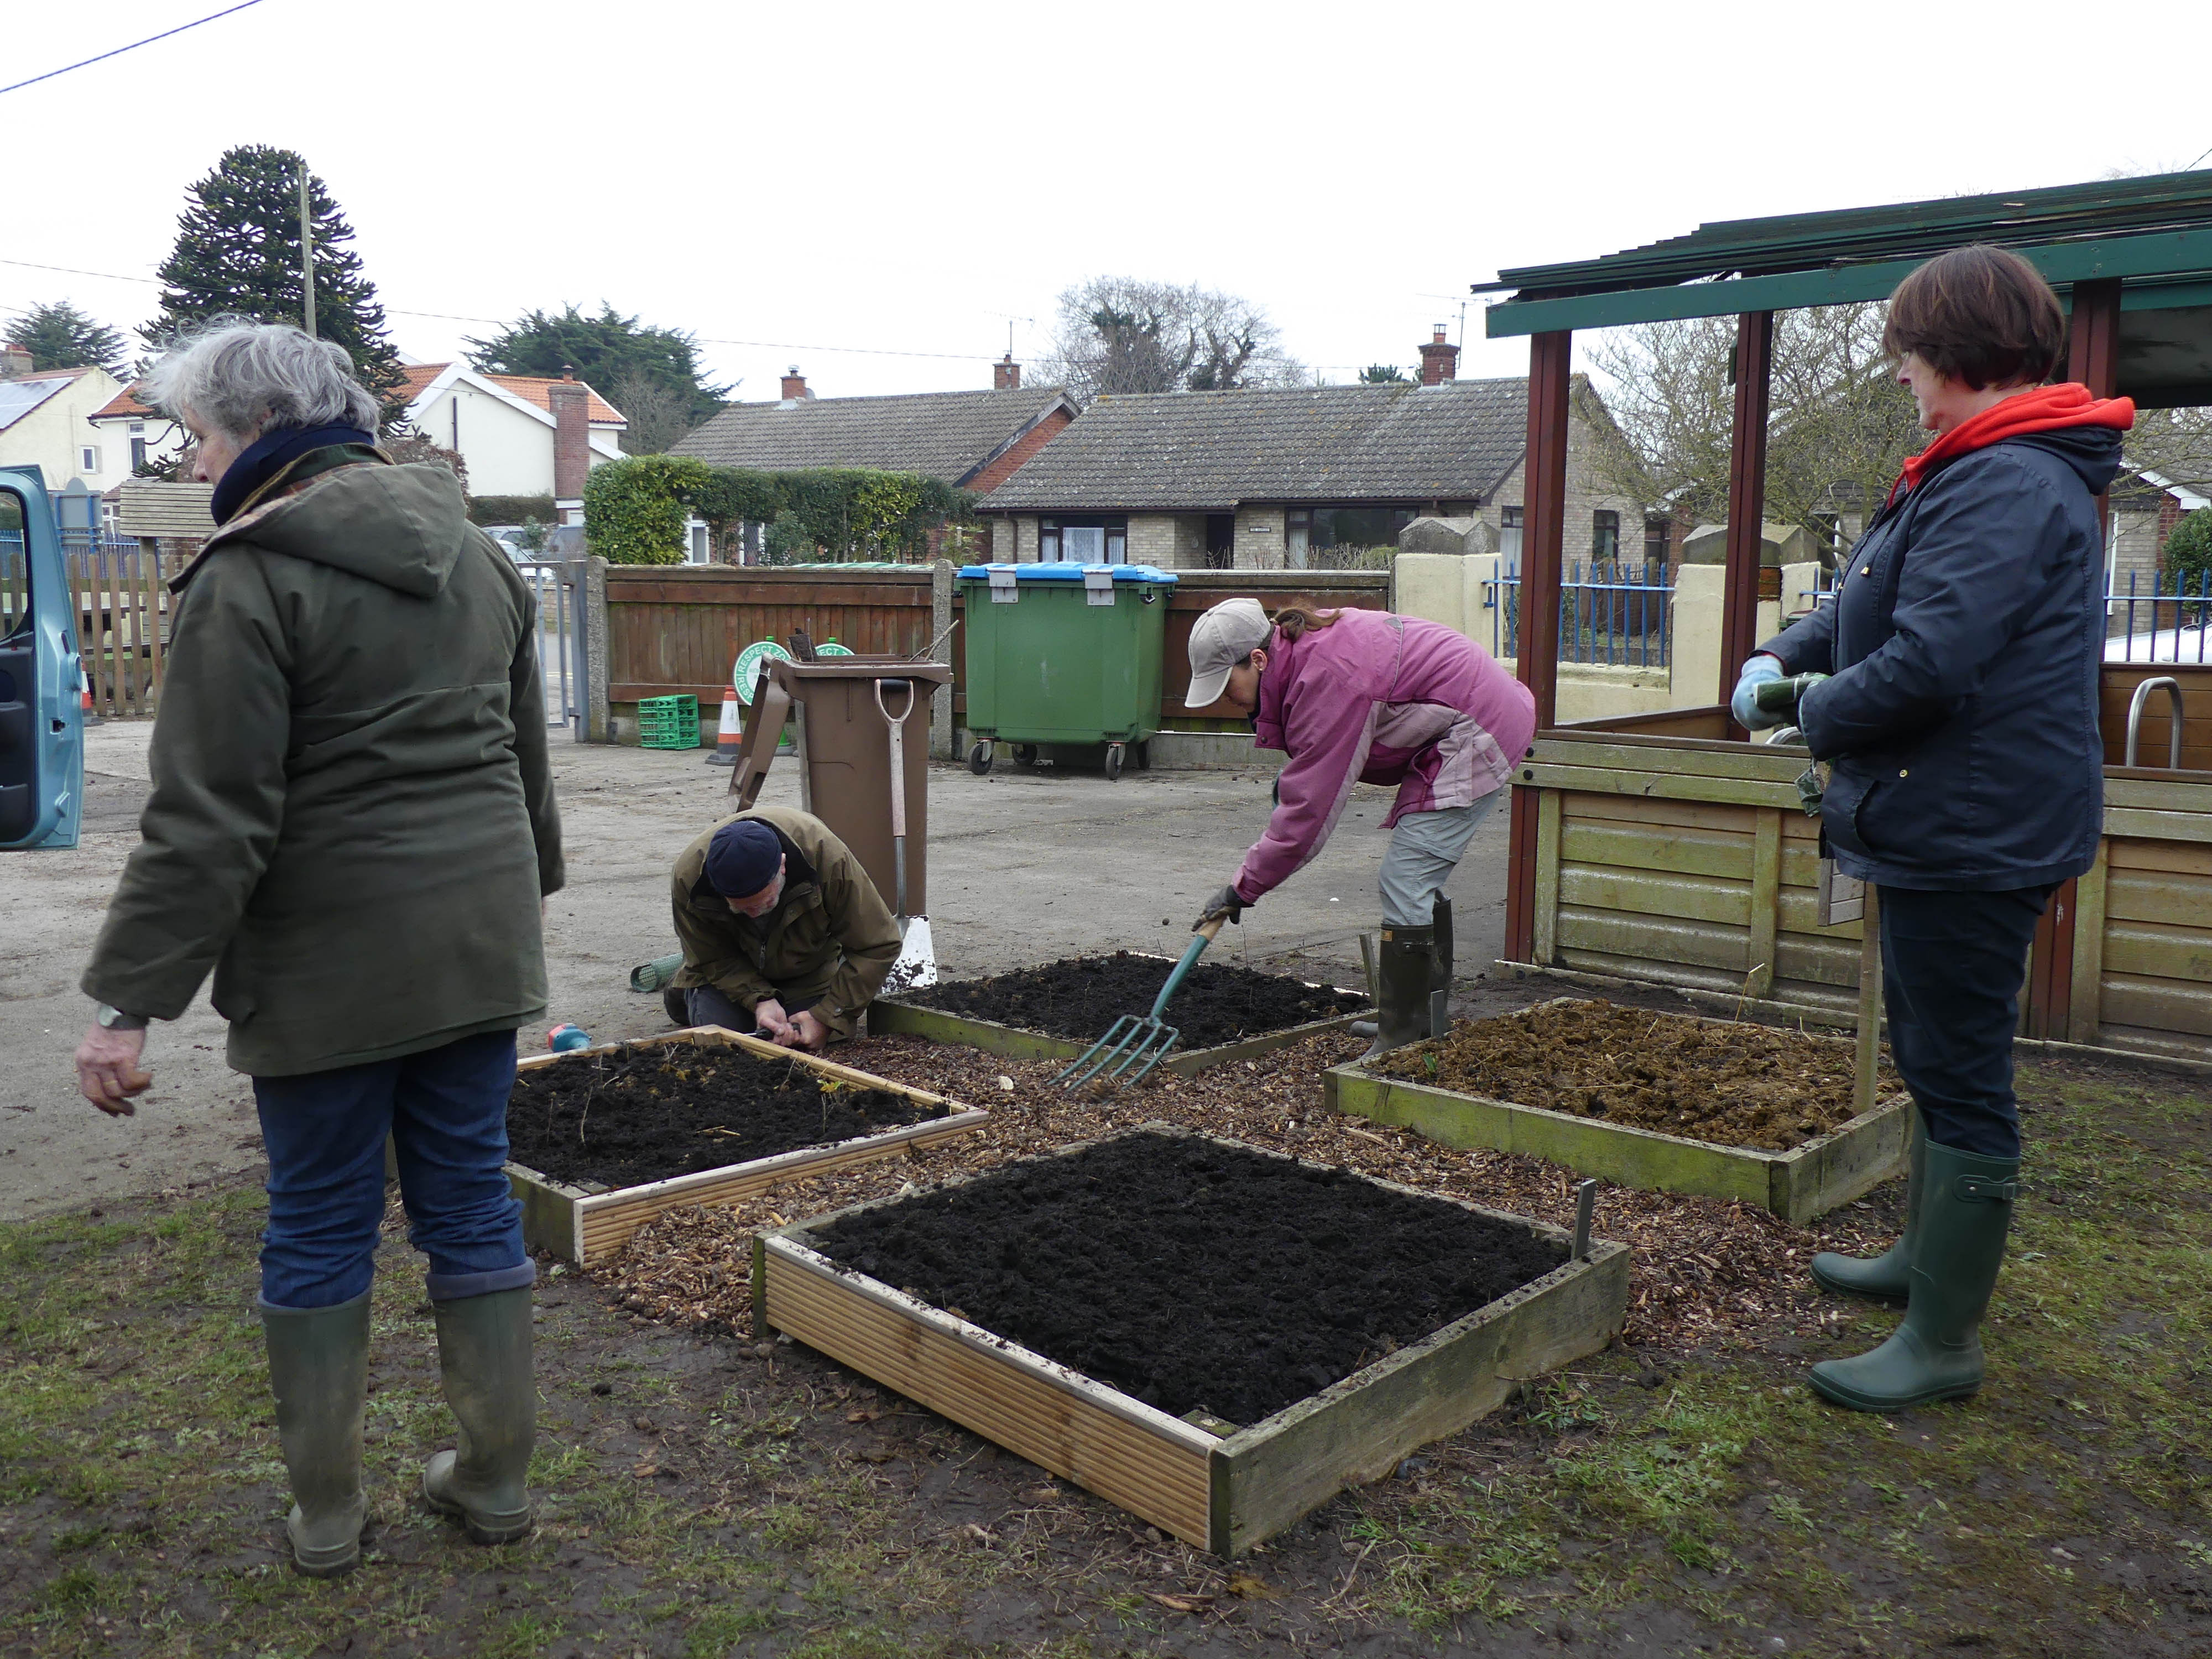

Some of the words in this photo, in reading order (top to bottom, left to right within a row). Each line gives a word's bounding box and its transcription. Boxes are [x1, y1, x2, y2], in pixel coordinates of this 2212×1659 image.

[738, 646, 773, 672] RESPECT
[775, 650, 786, 661] ZO
[817, 648, 839, 656] ECT
[737, 676, 754, 698] RESP
